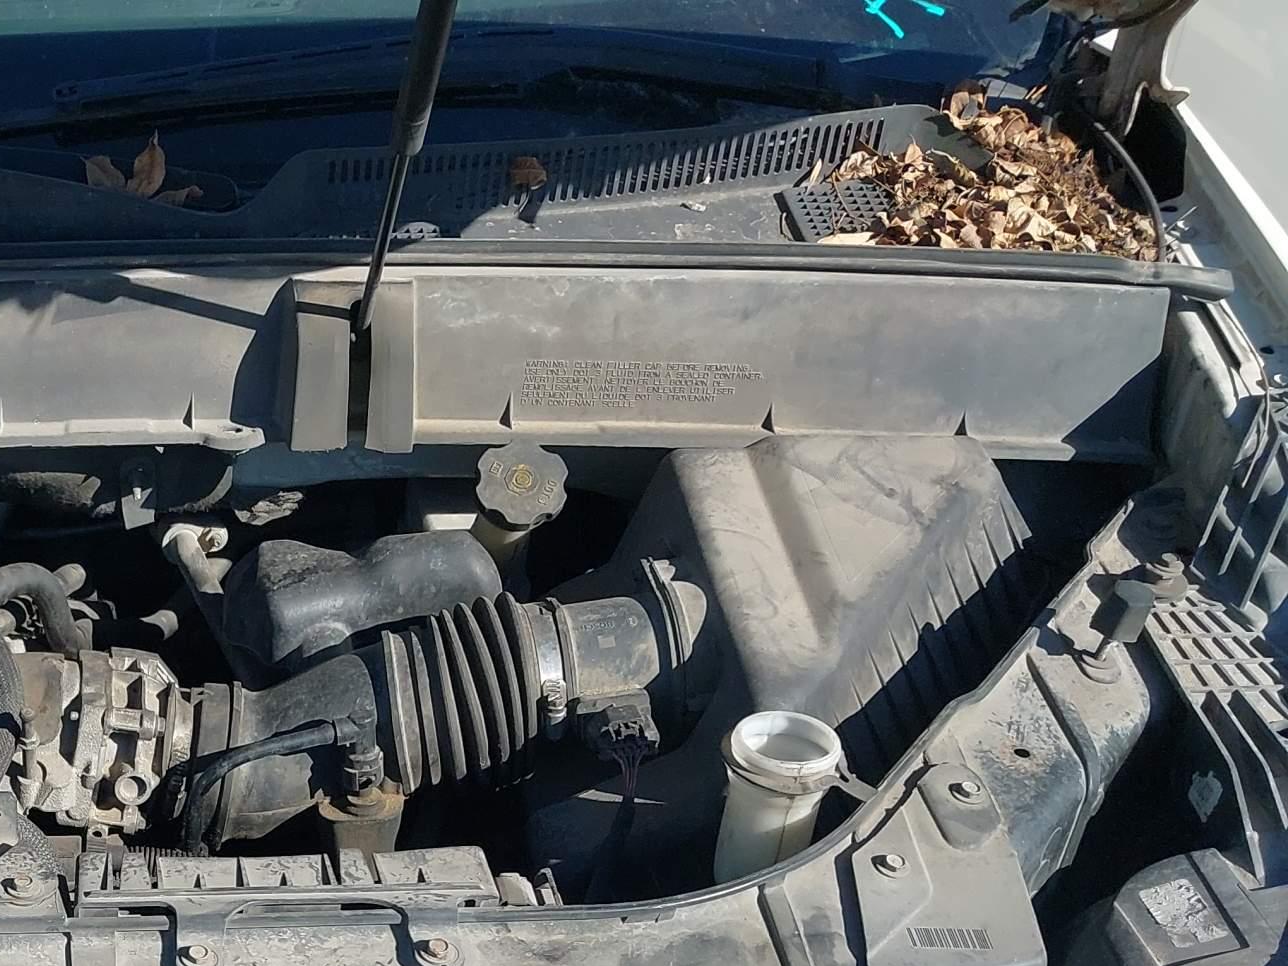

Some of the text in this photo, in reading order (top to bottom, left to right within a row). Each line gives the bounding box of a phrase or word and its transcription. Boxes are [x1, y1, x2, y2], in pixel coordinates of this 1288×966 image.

[574, 361, 602, 369] CLEAN
[606, 361, 640, 370] FILLER
[645, 362, 662, 370] CAP
[666, 362, 700, 371] BEFORE
[524, 367, 542, 376] USE
[546, 368, 566, 376] ONLY
[573, 369, 588, 377] DOT
[676, 371, 710, 379] SEALED
[604, 377, 648, 385] NETTOYER
[669, 379, 708, 387] BOUCHON
[522, 383, 584, 391] REMPLISSAGE
[588, 384, 614, 392] AVANT
[690, 387, 736, 395] UTILISER
[521, 391, 569, 399] SEULEMENT
[666, 394, 716, 403] PROVENANT
[547, 399, 596, 407] CONTENANT
